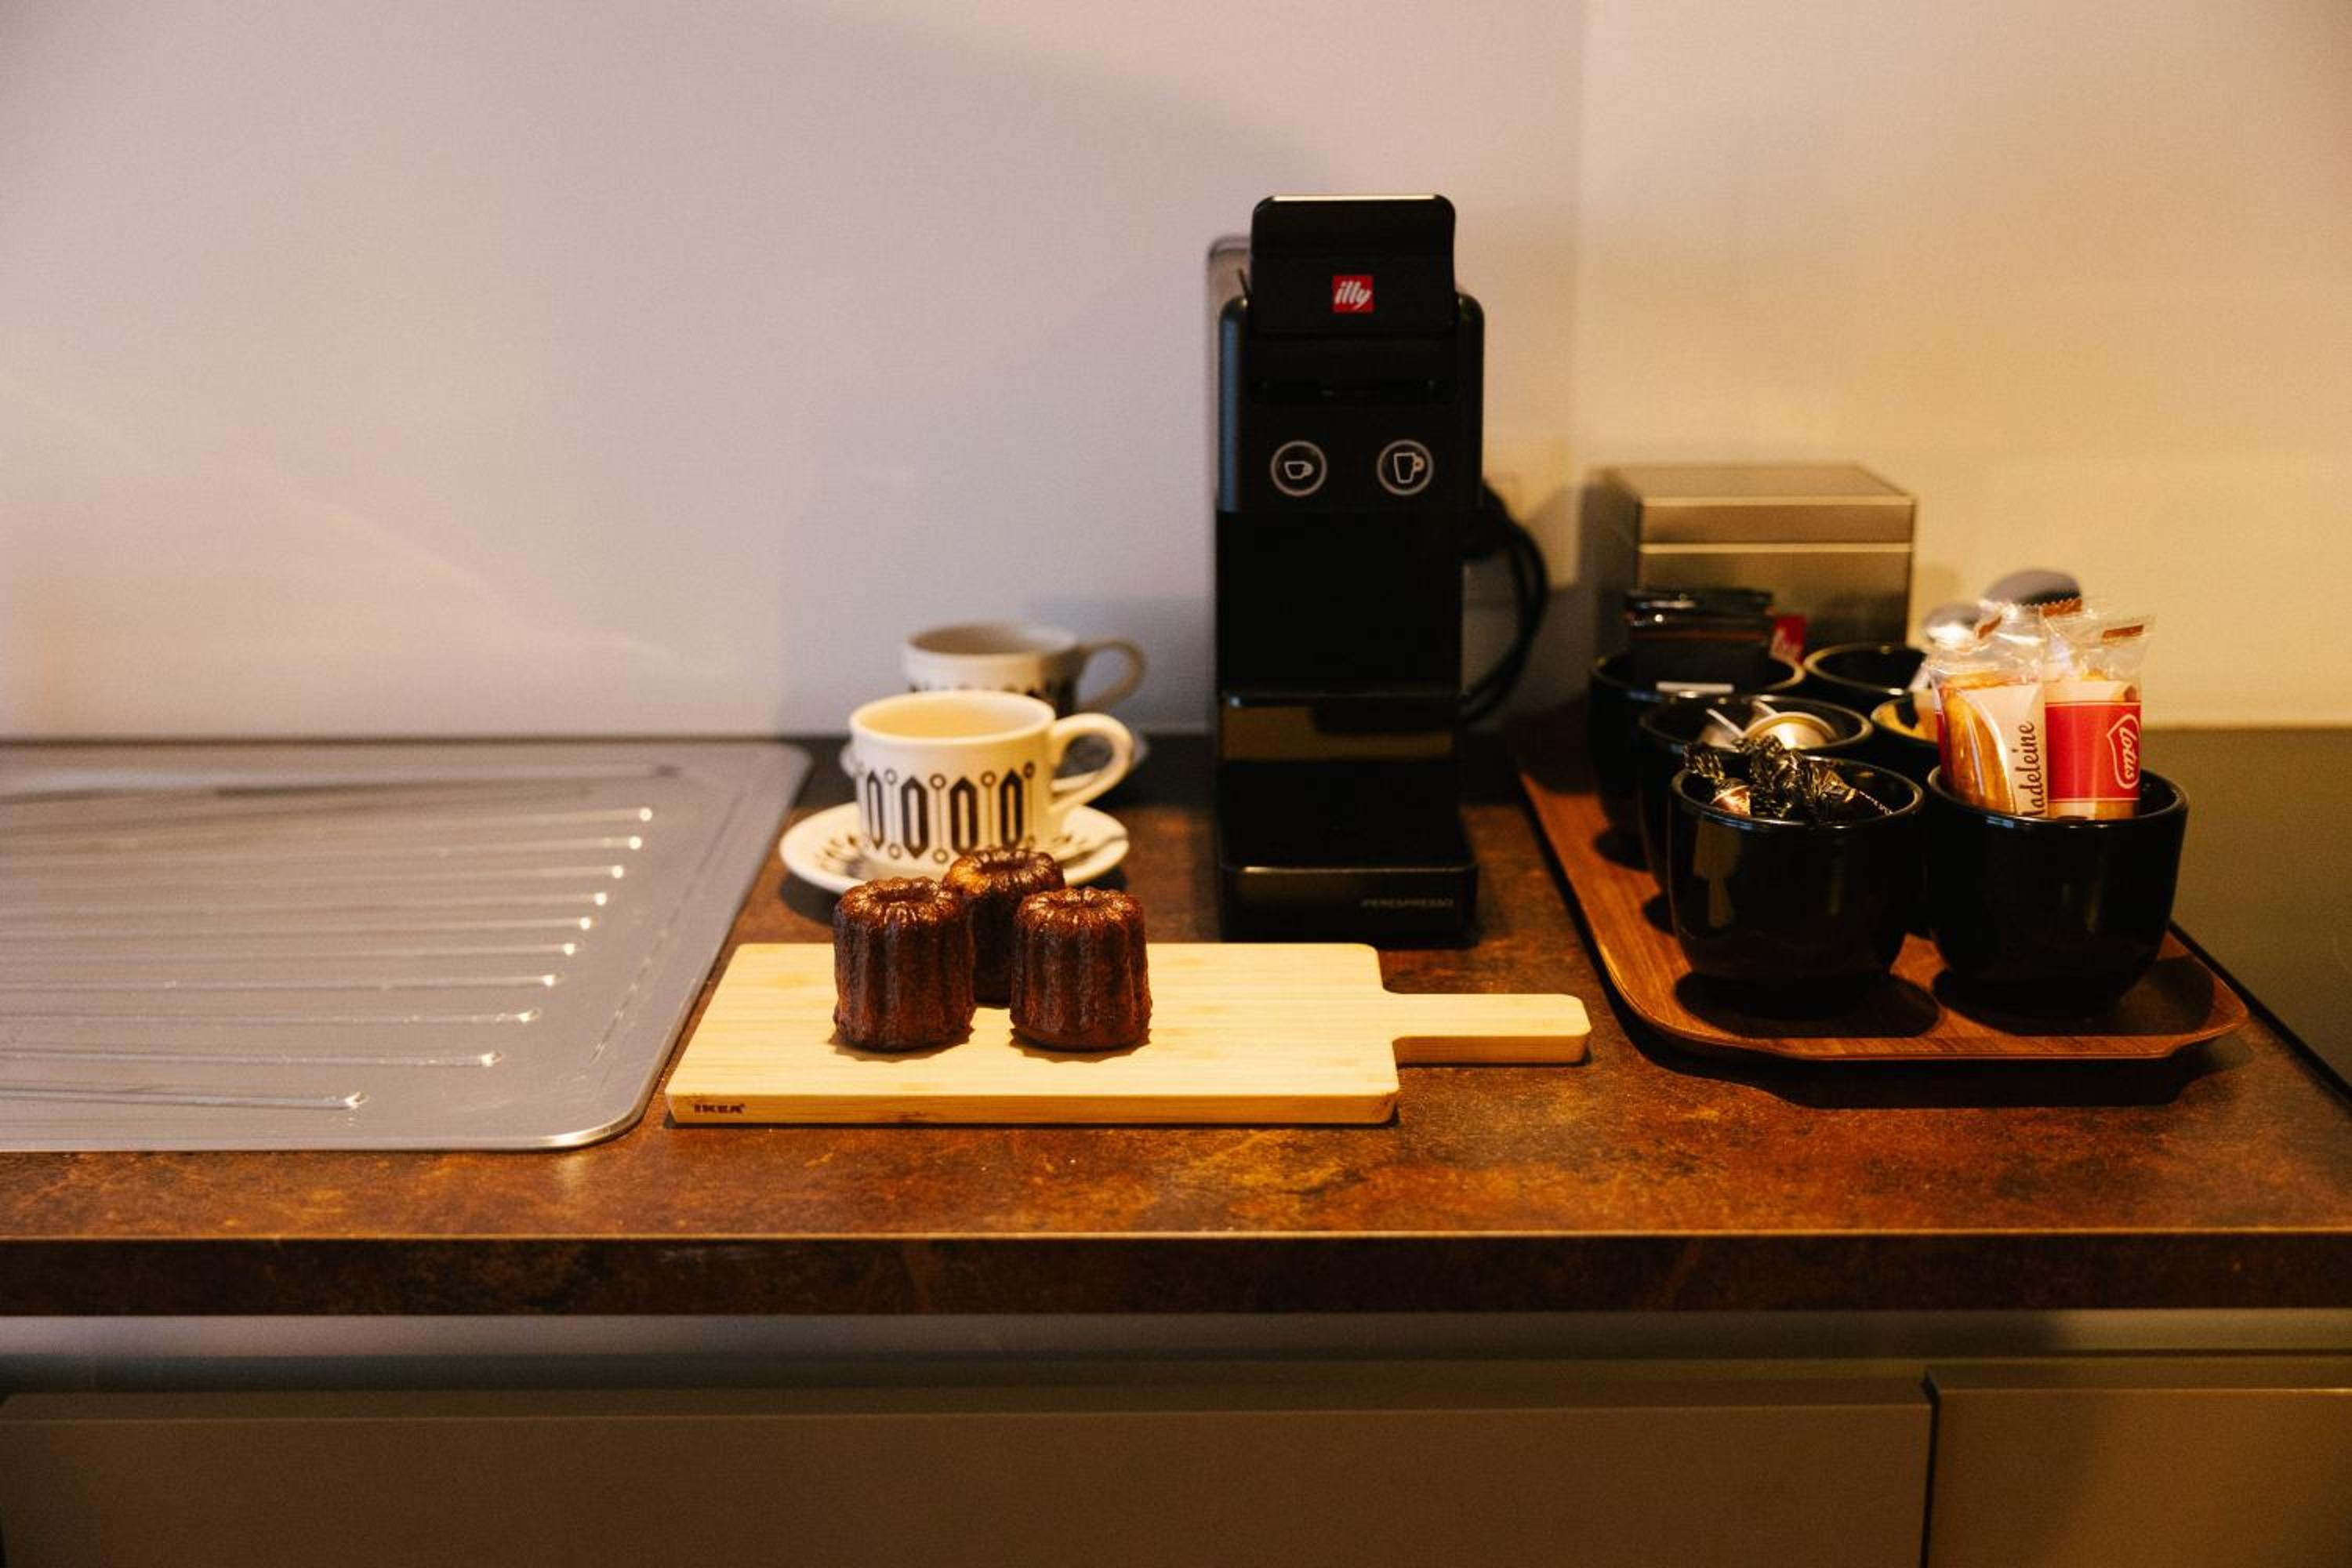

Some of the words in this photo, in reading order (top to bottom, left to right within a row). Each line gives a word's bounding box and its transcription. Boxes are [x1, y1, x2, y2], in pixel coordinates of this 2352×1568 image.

[1334, 281, 1372, 310] illy
[2118, 727, 2140, 780] Lotus
[694, 1102, 742, 1114] IKEA
